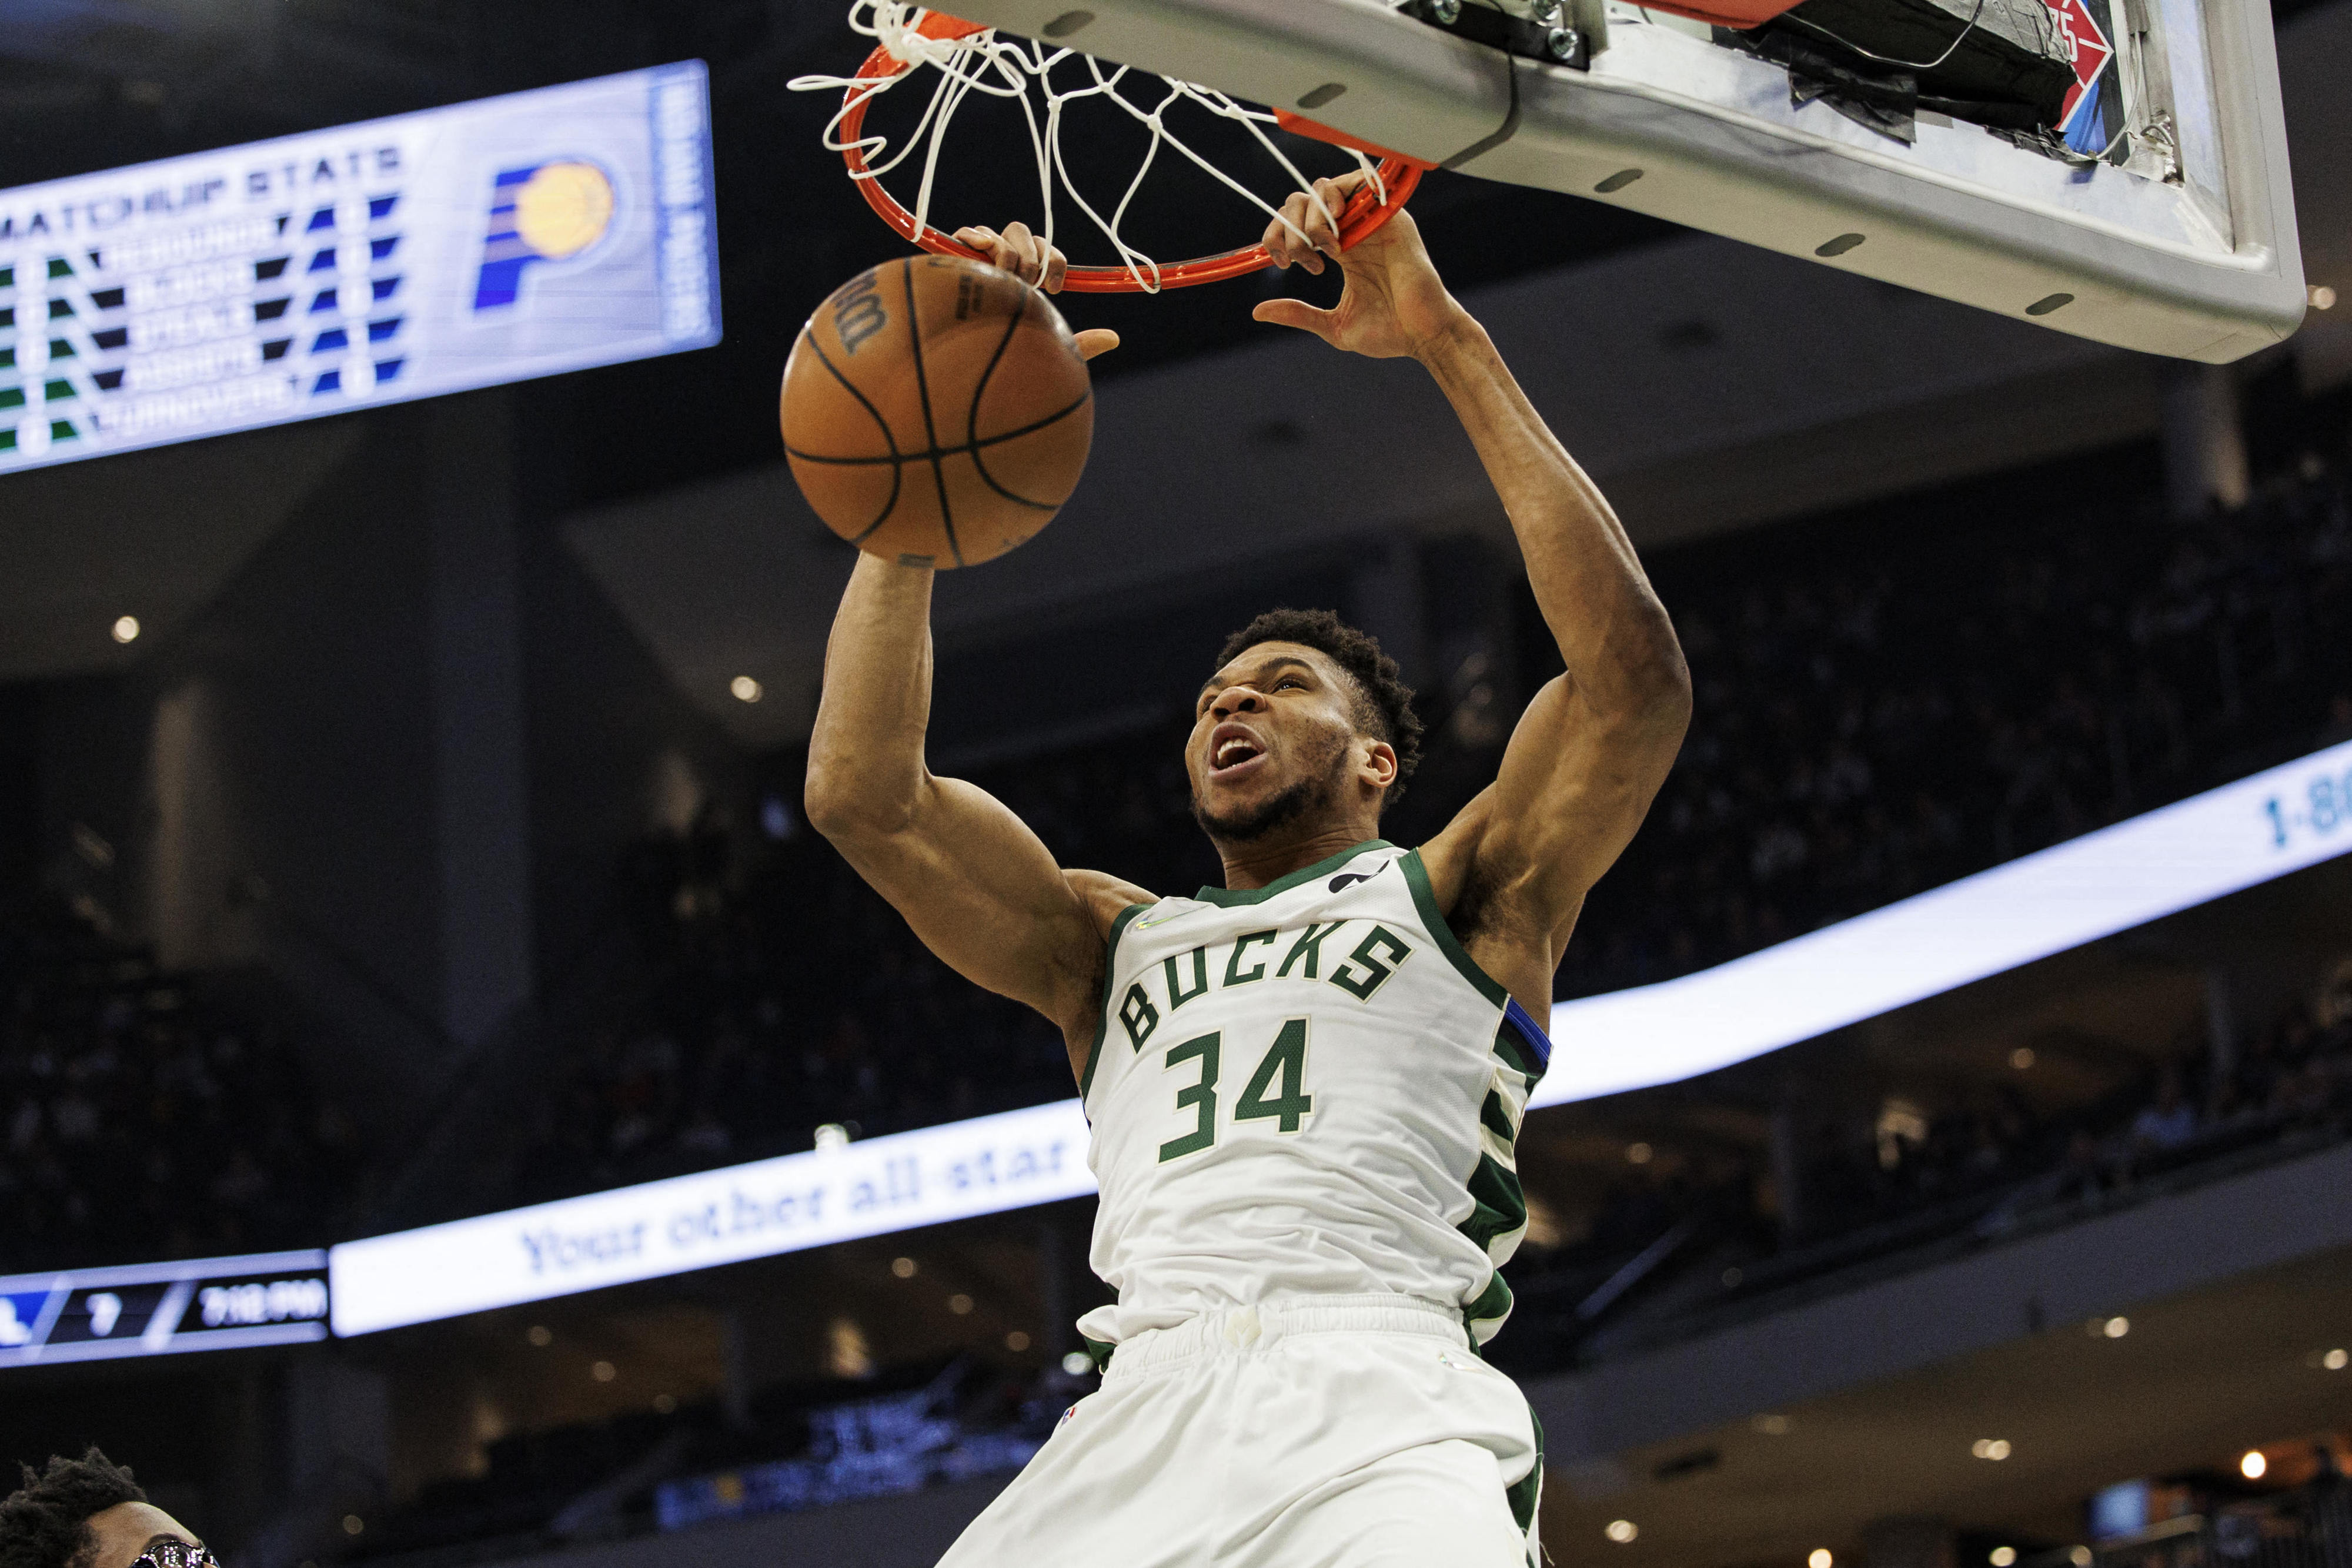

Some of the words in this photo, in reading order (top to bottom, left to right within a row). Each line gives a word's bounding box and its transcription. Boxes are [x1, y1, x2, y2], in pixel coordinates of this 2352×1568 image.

[1117, 919, 1415, 1054] BUCKS
[1154, 1014, 1316, 1165] 34
[521, 1221, 646, 1276] Your
[667, 1186, 826, 1250] other
